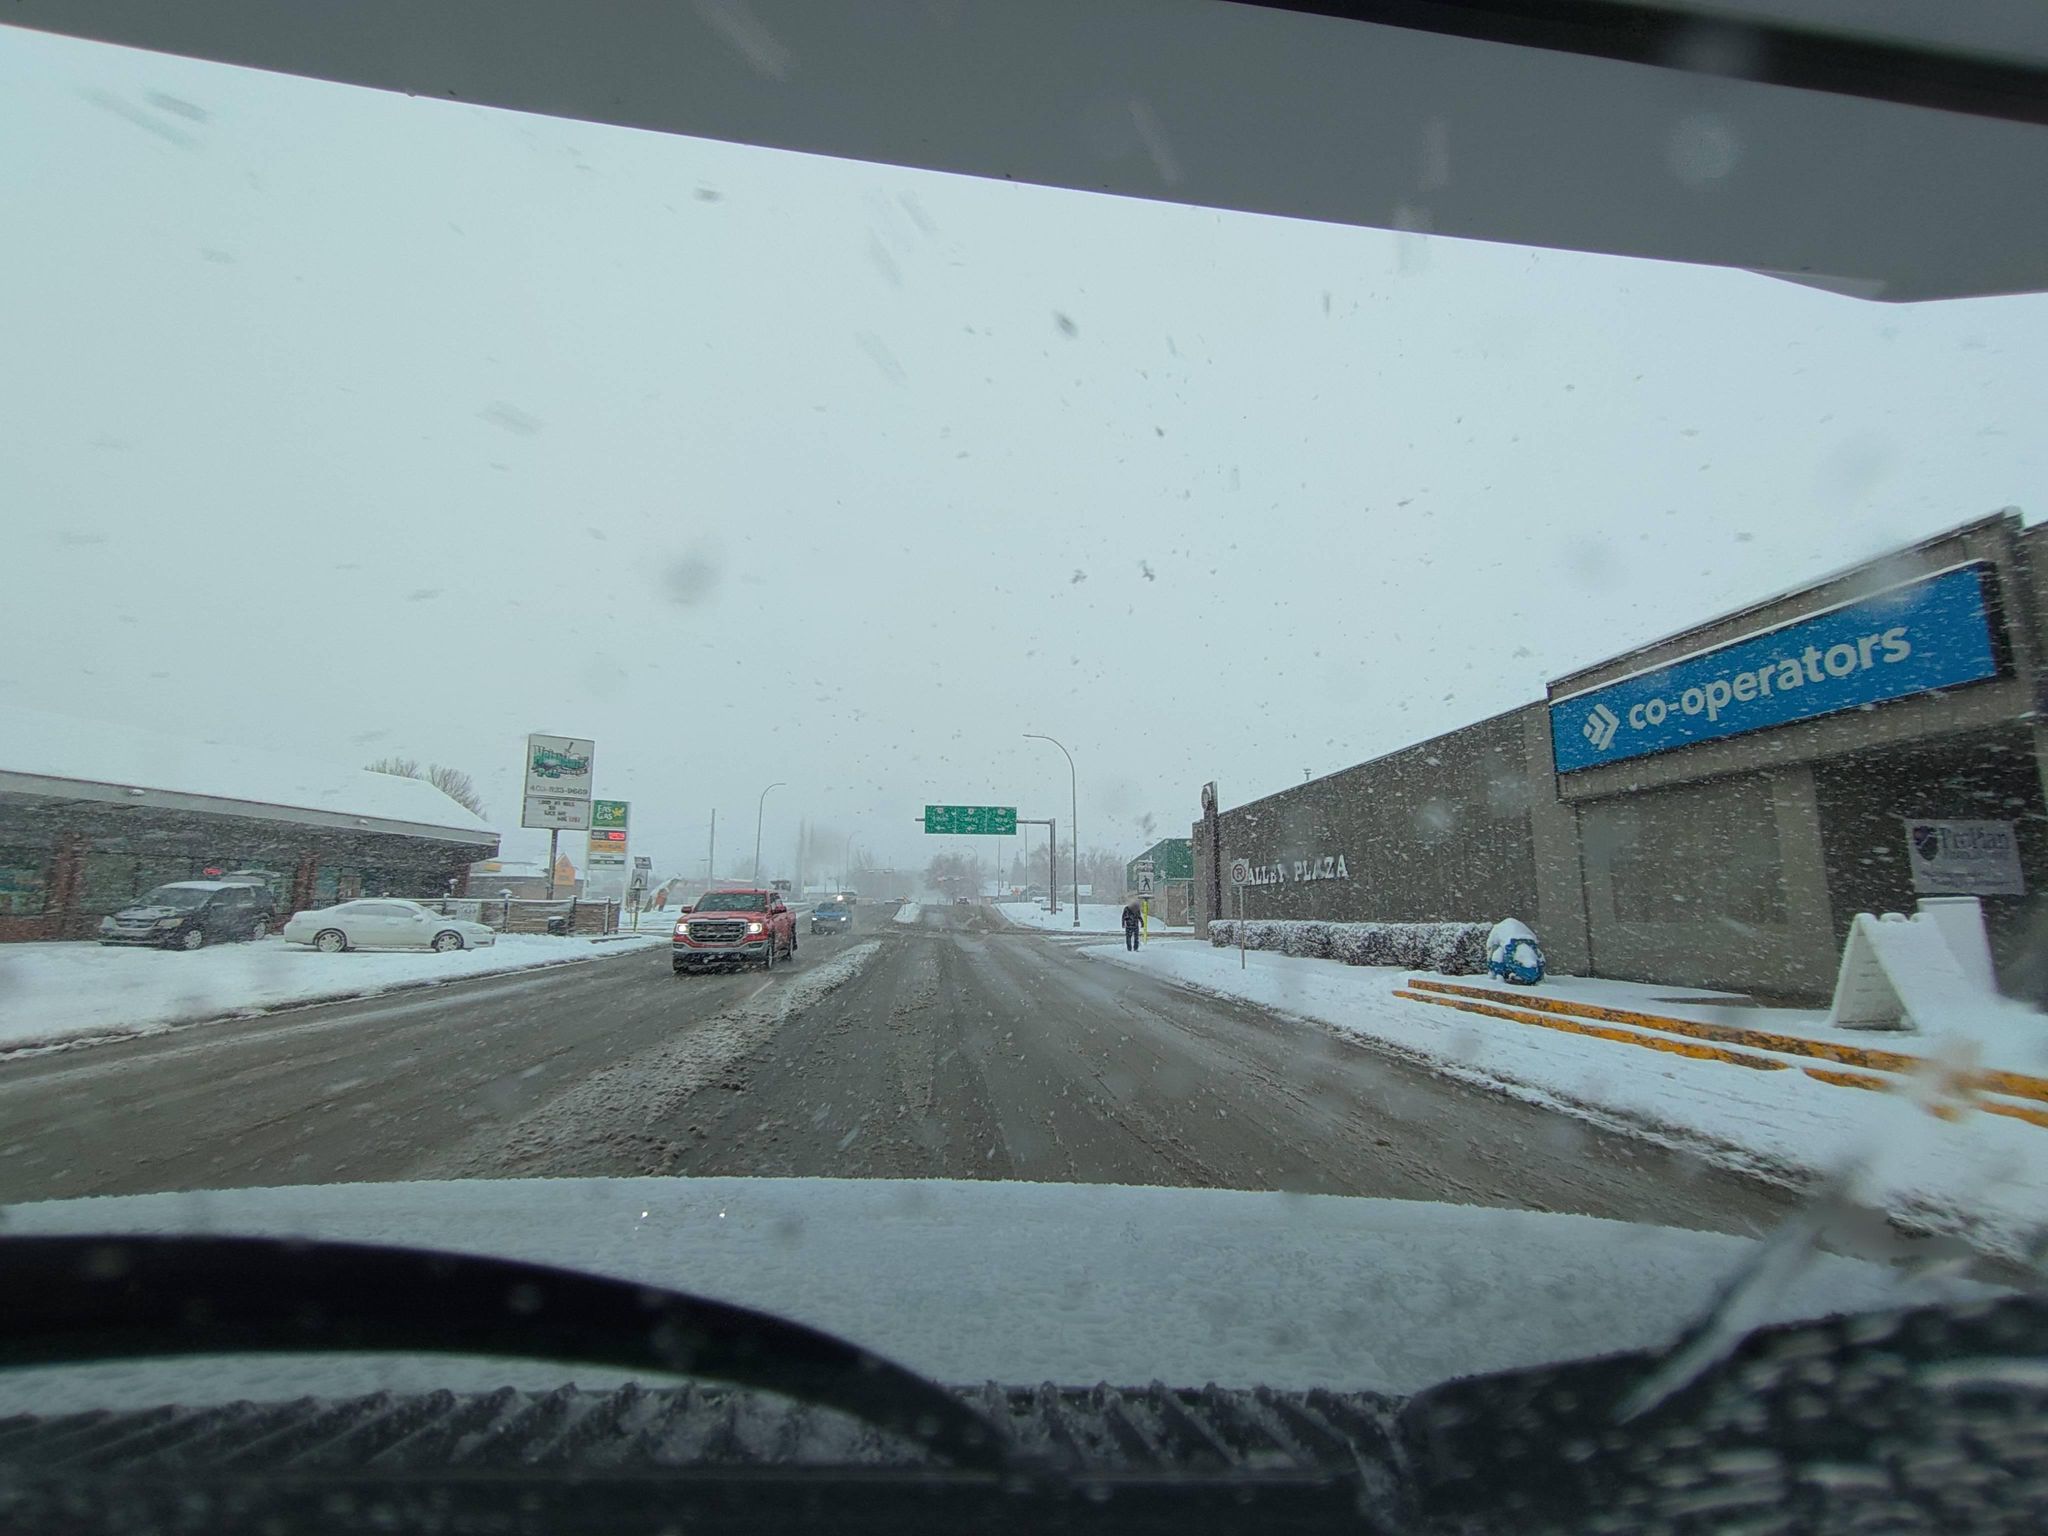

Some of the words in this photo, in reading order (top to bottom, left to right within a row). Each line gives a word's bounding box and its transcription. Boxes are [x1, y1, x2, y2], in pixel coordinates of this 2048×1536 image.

[1628, 627, 1912, 722] co-operators
[1247, 864, 1286, 886] ALLEY
[1294, 854, 1350, 882] PLAZA
